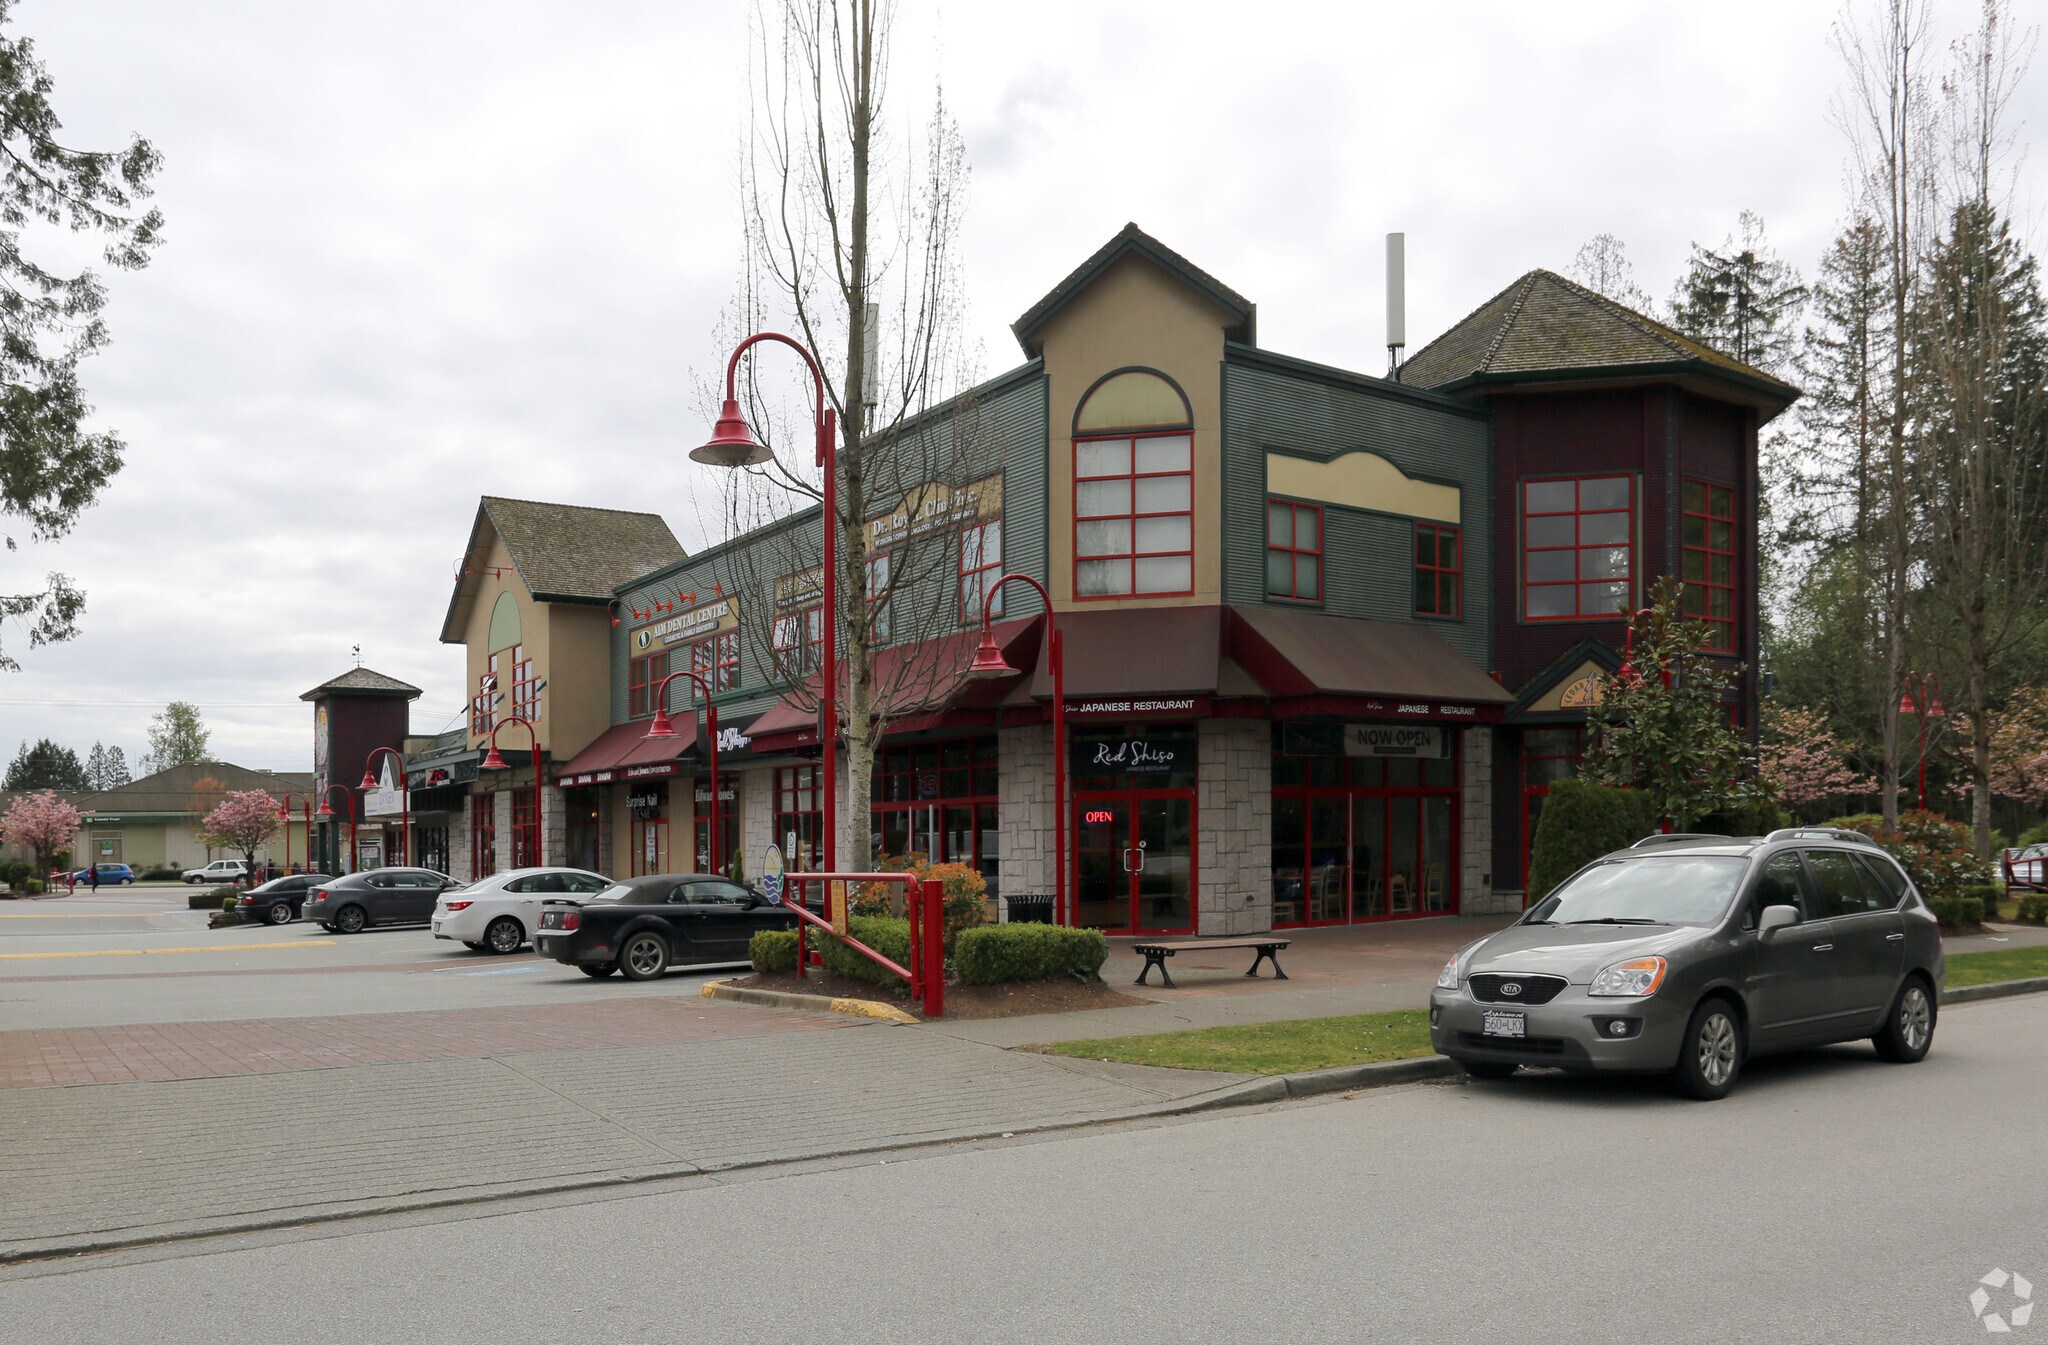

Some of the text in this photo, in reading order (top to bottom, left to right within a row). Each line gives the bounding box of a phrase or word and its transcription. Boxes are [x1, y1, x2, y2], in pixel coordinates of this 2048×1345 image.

[653, 601, 728, 638] AIM DENTAL CENTRE
[1564, 682, 1585, 704] CEDAR
[1080, 702, 1131, 713] JAPANESE
[1133, 700, 1195, 711] RESTAURANT
[1397, 704, 1430, 714] JAPANESE
[1440, 706, 1476, 716] RESTAURANT
[1357, 729, 1431, 747] NOW OPEN
[1093, 741, 1174, 766] Red Shiso
[625, 793, 658, 810] Surprise Nail
[695, 789, 735, 802] Edwa ones
[1086, 811, 1112, 823] OPEN
[1503, 985, 1518, 993] KIA
